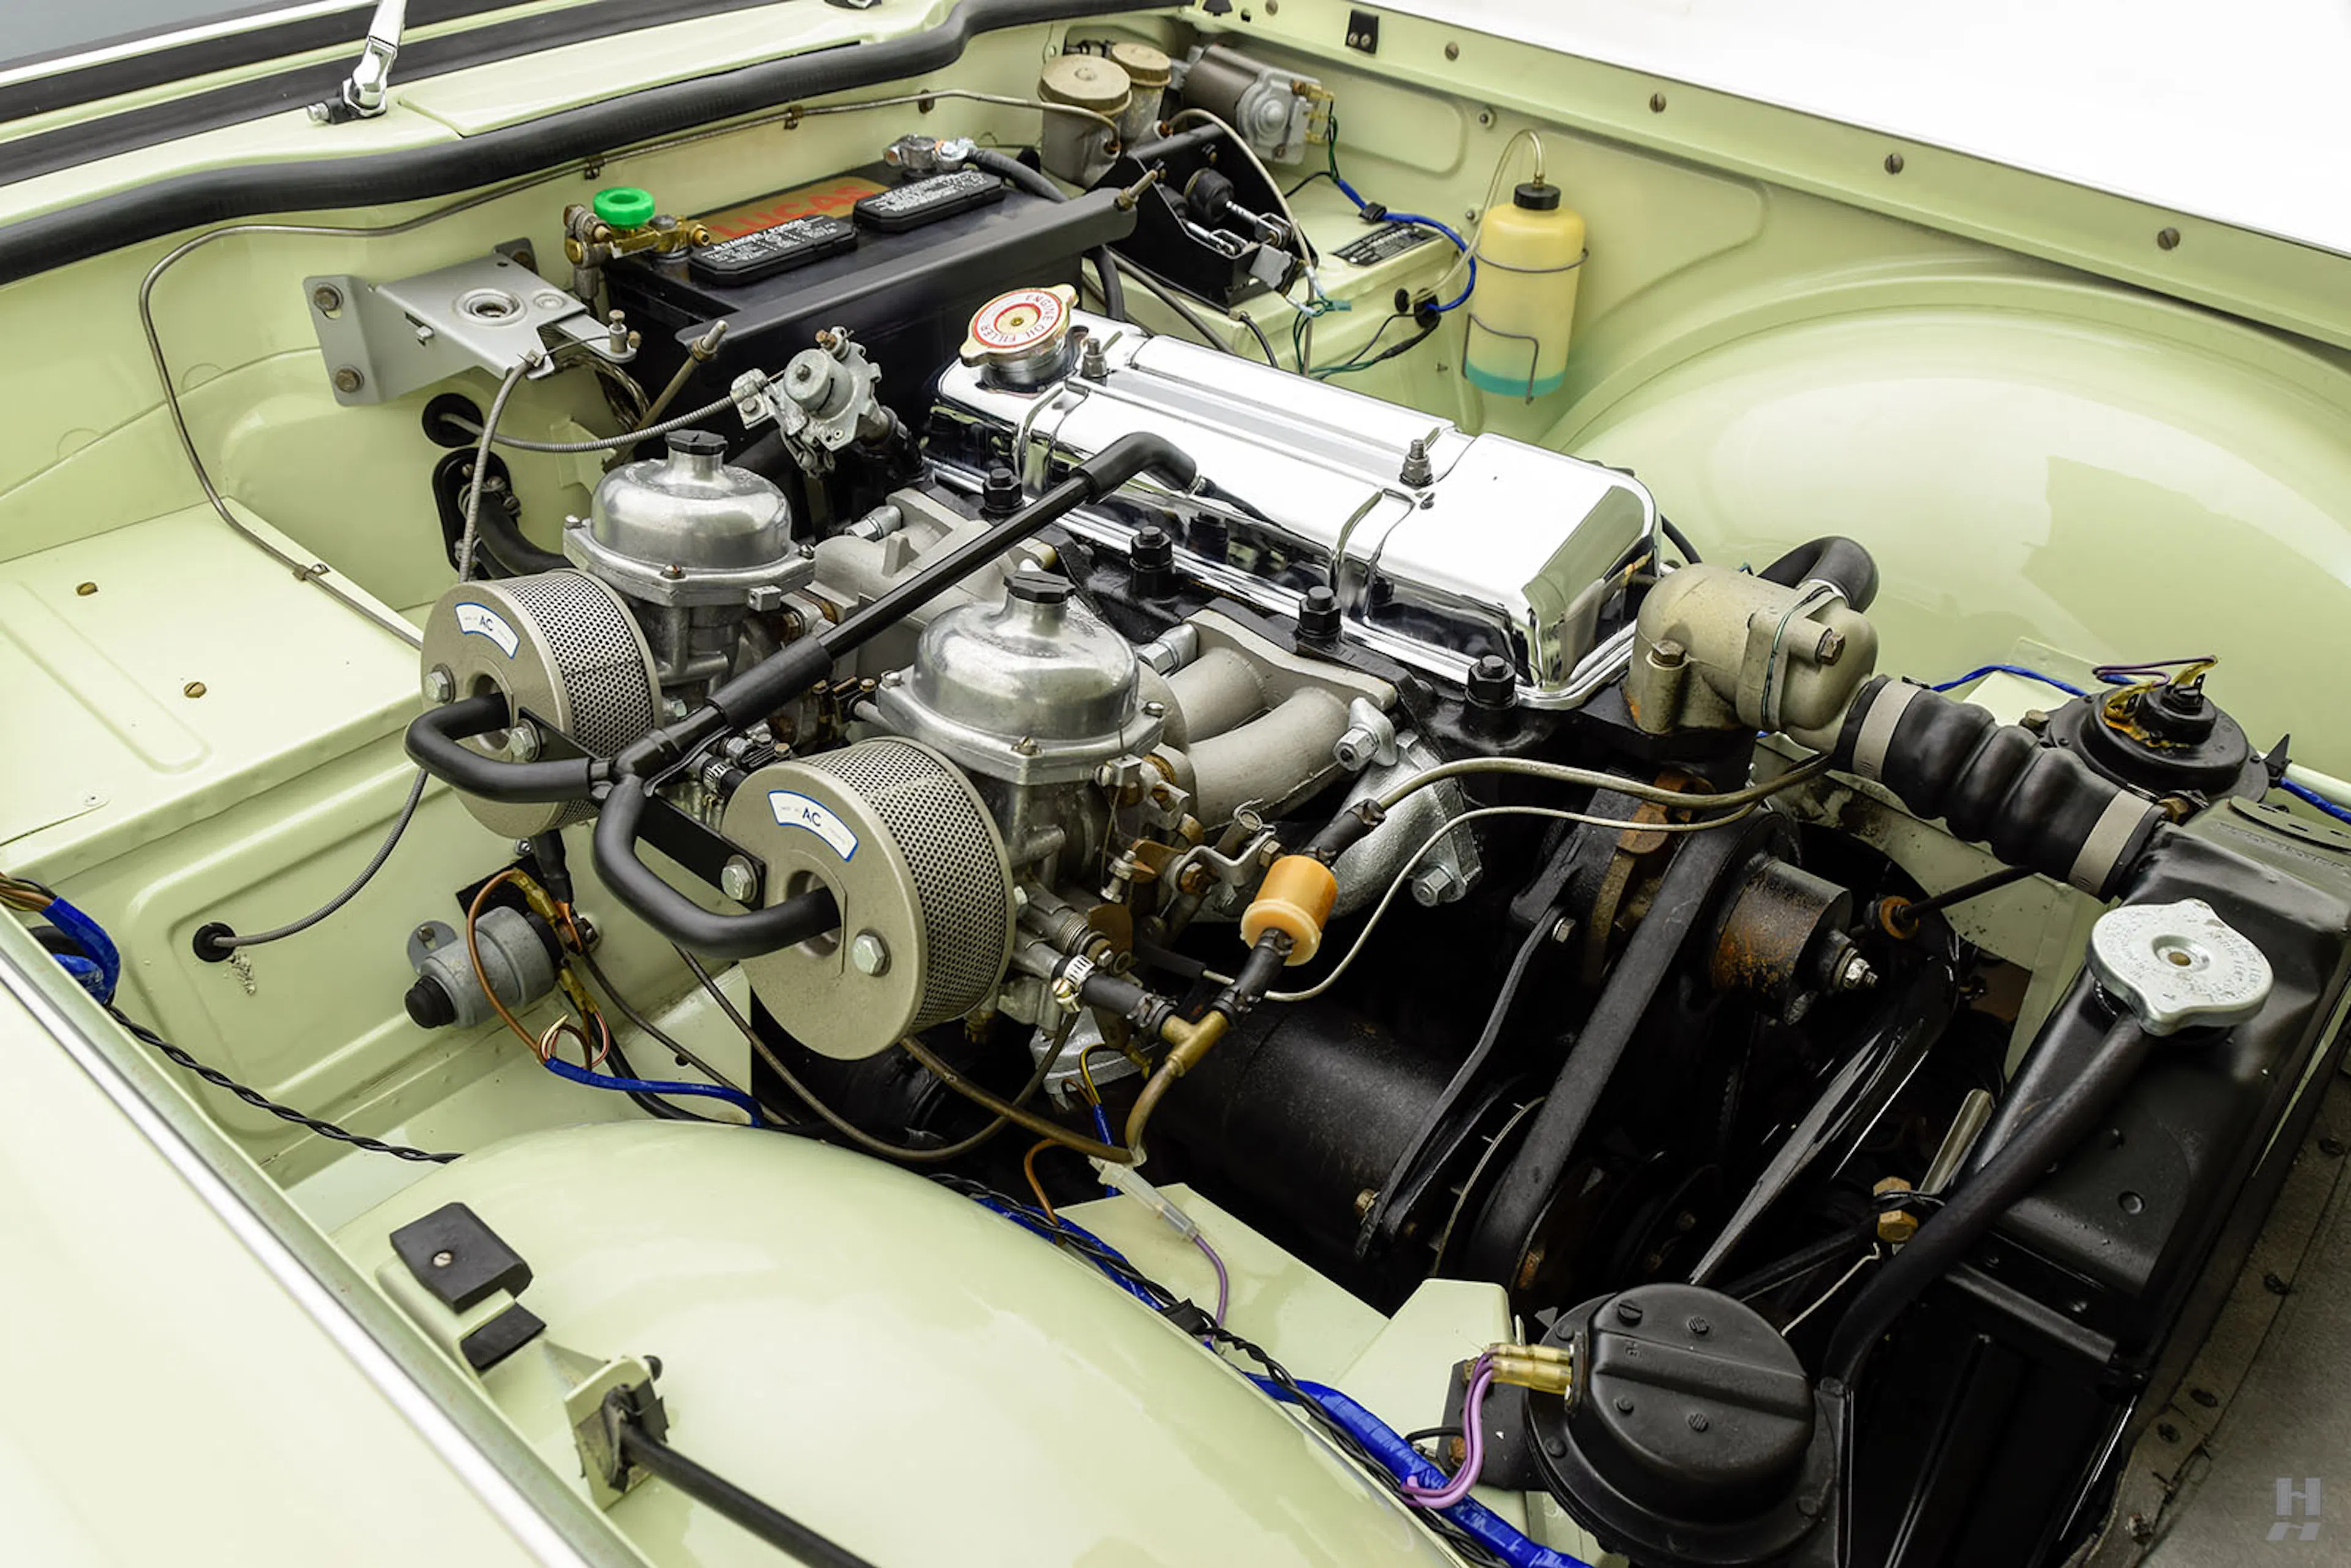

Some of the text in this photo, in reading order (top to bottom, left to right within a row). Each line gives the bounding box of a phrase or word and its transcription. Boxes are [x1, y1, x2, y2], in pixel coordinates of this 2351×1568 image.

[709, 185, 877, 238] LUCAS
[980, 294, 1056, 342] ENGINE OIL FILLER
[479, 615, 494, 631] AC
[802, 807, 822, 827] AC
